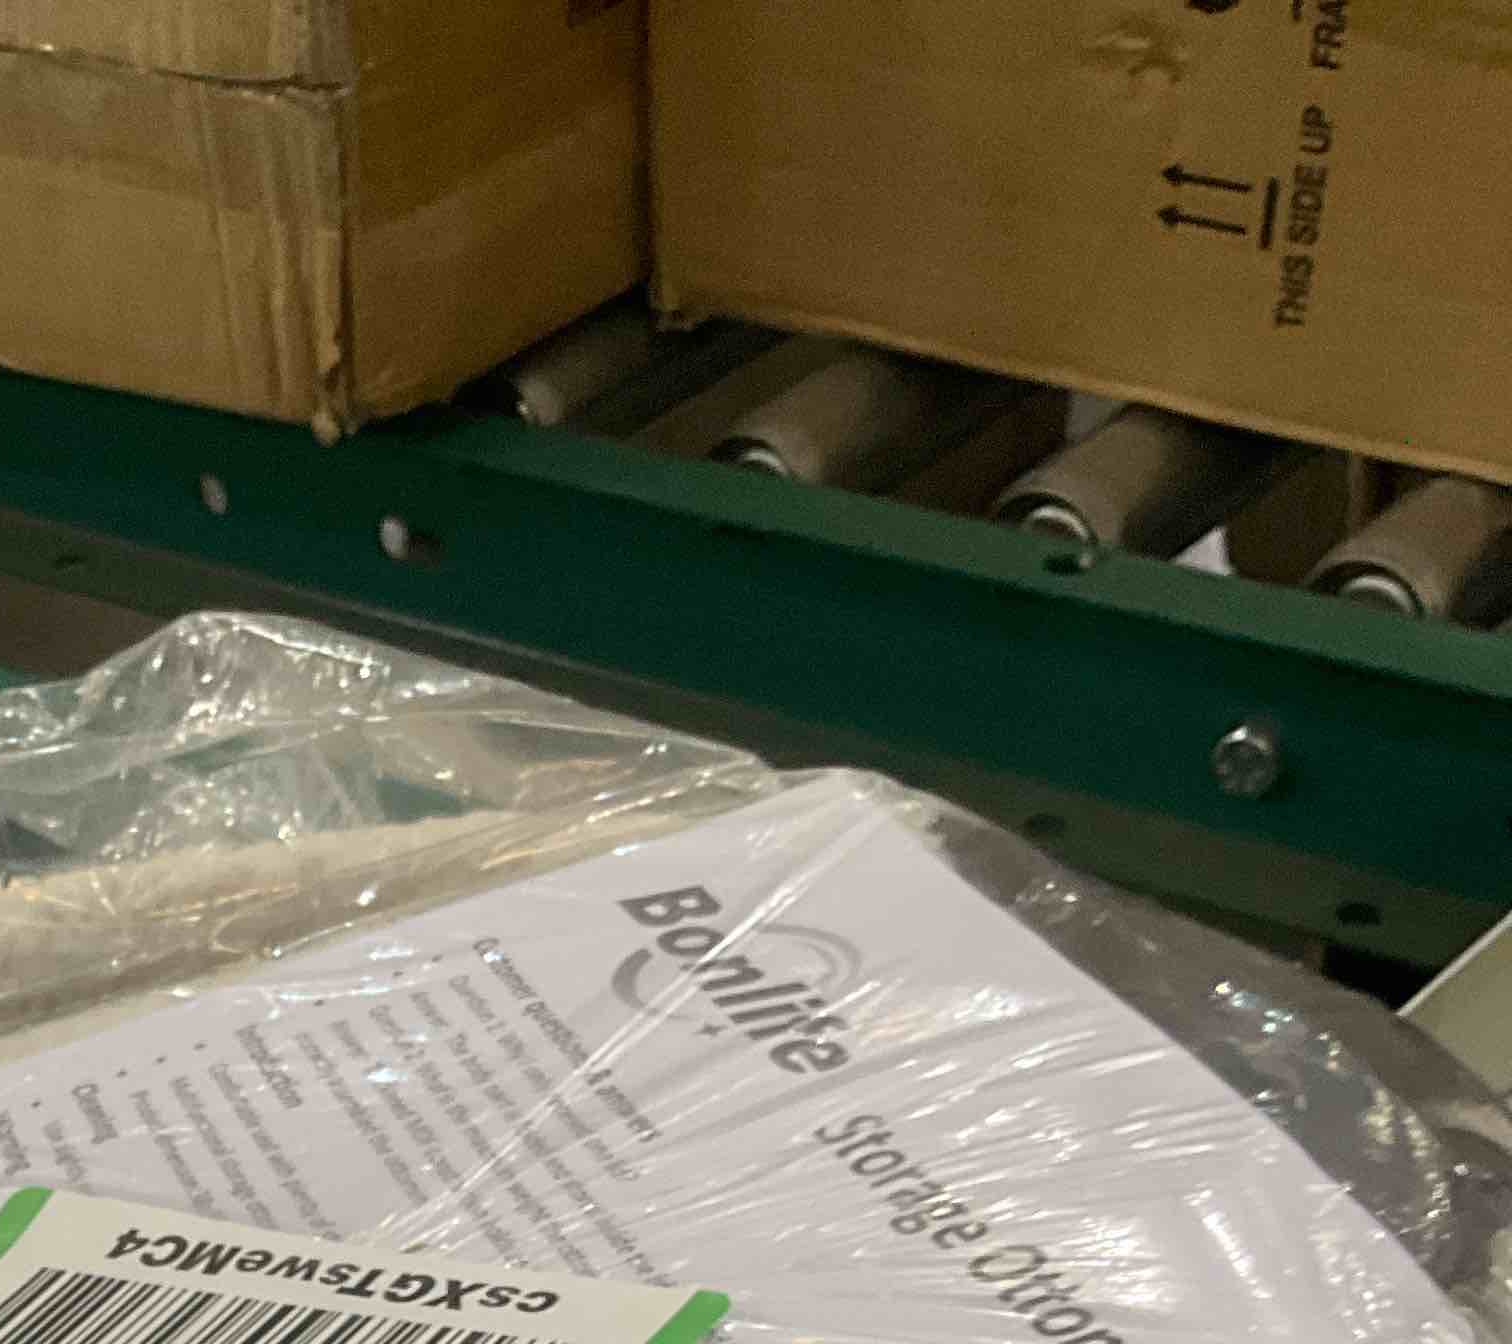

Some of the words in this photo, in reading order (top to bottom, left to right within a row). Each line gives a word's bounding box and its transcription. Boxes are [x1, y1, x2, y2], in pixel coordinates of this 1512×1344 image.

[1299, 105, 1335, 154] UP
[1288, 164, 1329, 245] SIDE
[1274, 256, 1314, 328] THIS
[814, 1113, 988, 1251] Storage
[105, 1226, 561, 1314] csXGTsweMC4
